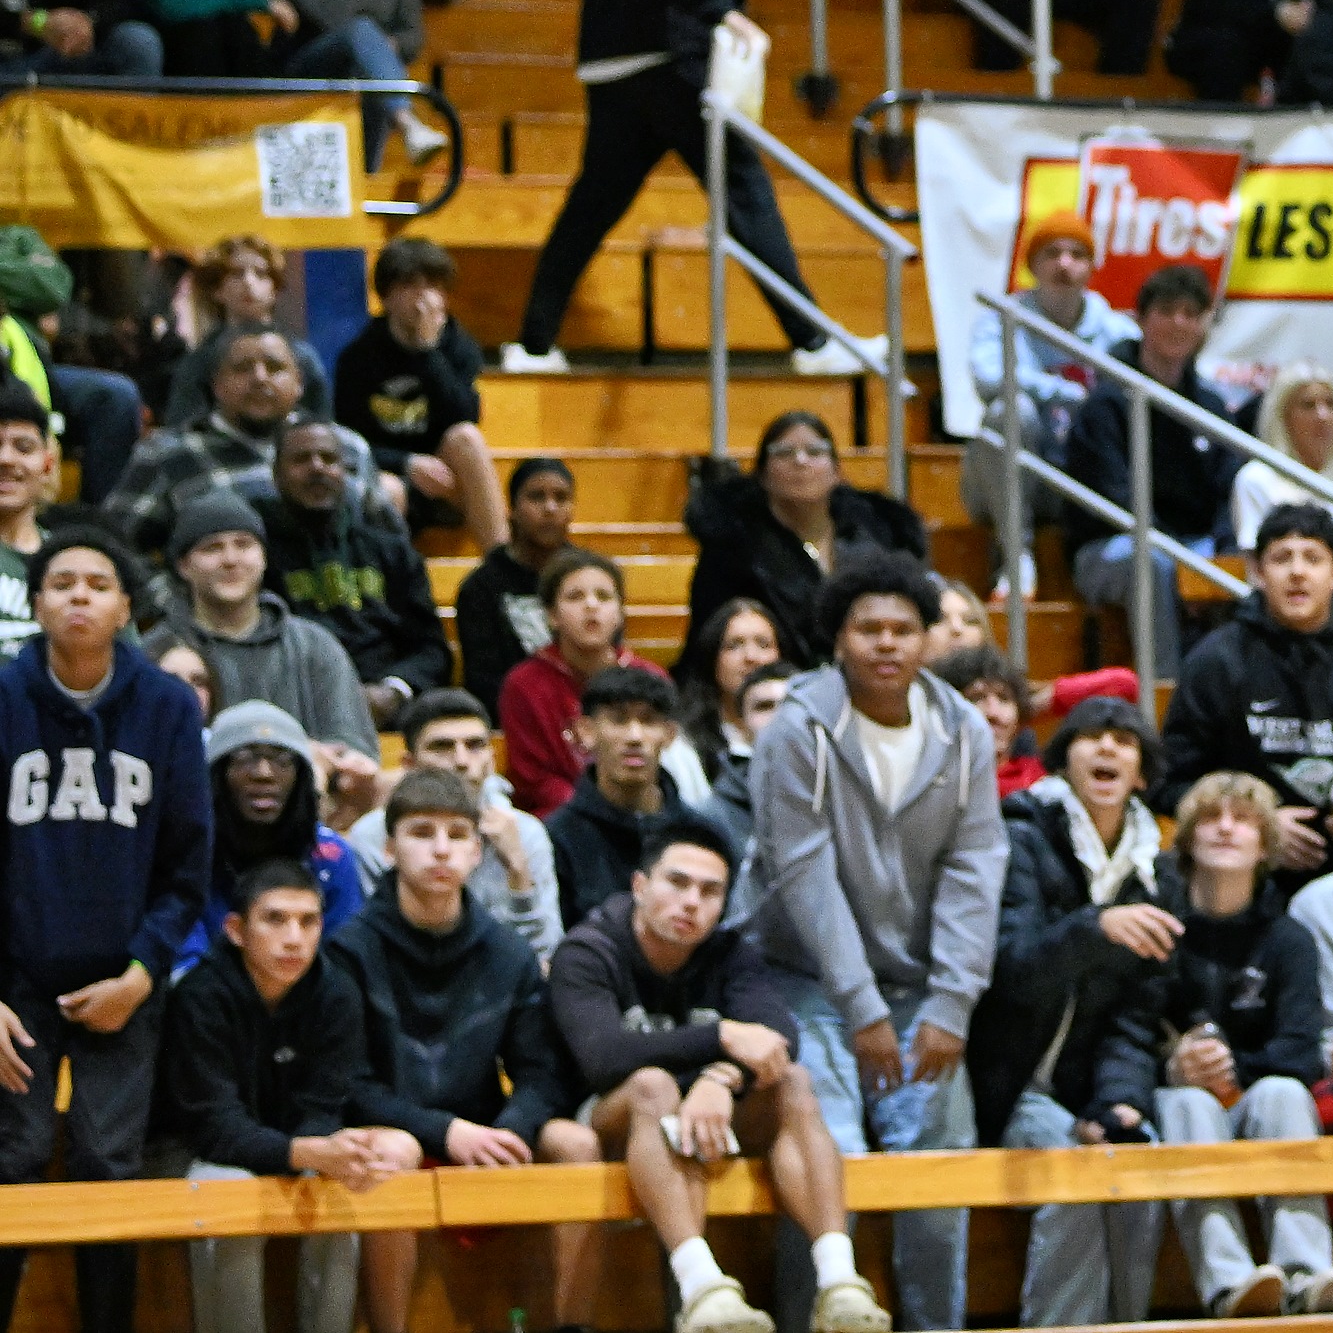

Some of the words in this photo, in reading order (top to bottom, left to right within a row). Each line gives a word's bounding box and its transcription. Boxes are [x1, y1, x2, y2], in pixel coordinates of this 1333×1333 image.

[1090, 163, 1229, 271] Tires
[1247, 202, 1332, 262] LES
[8, 747, 153, 828] GAP
